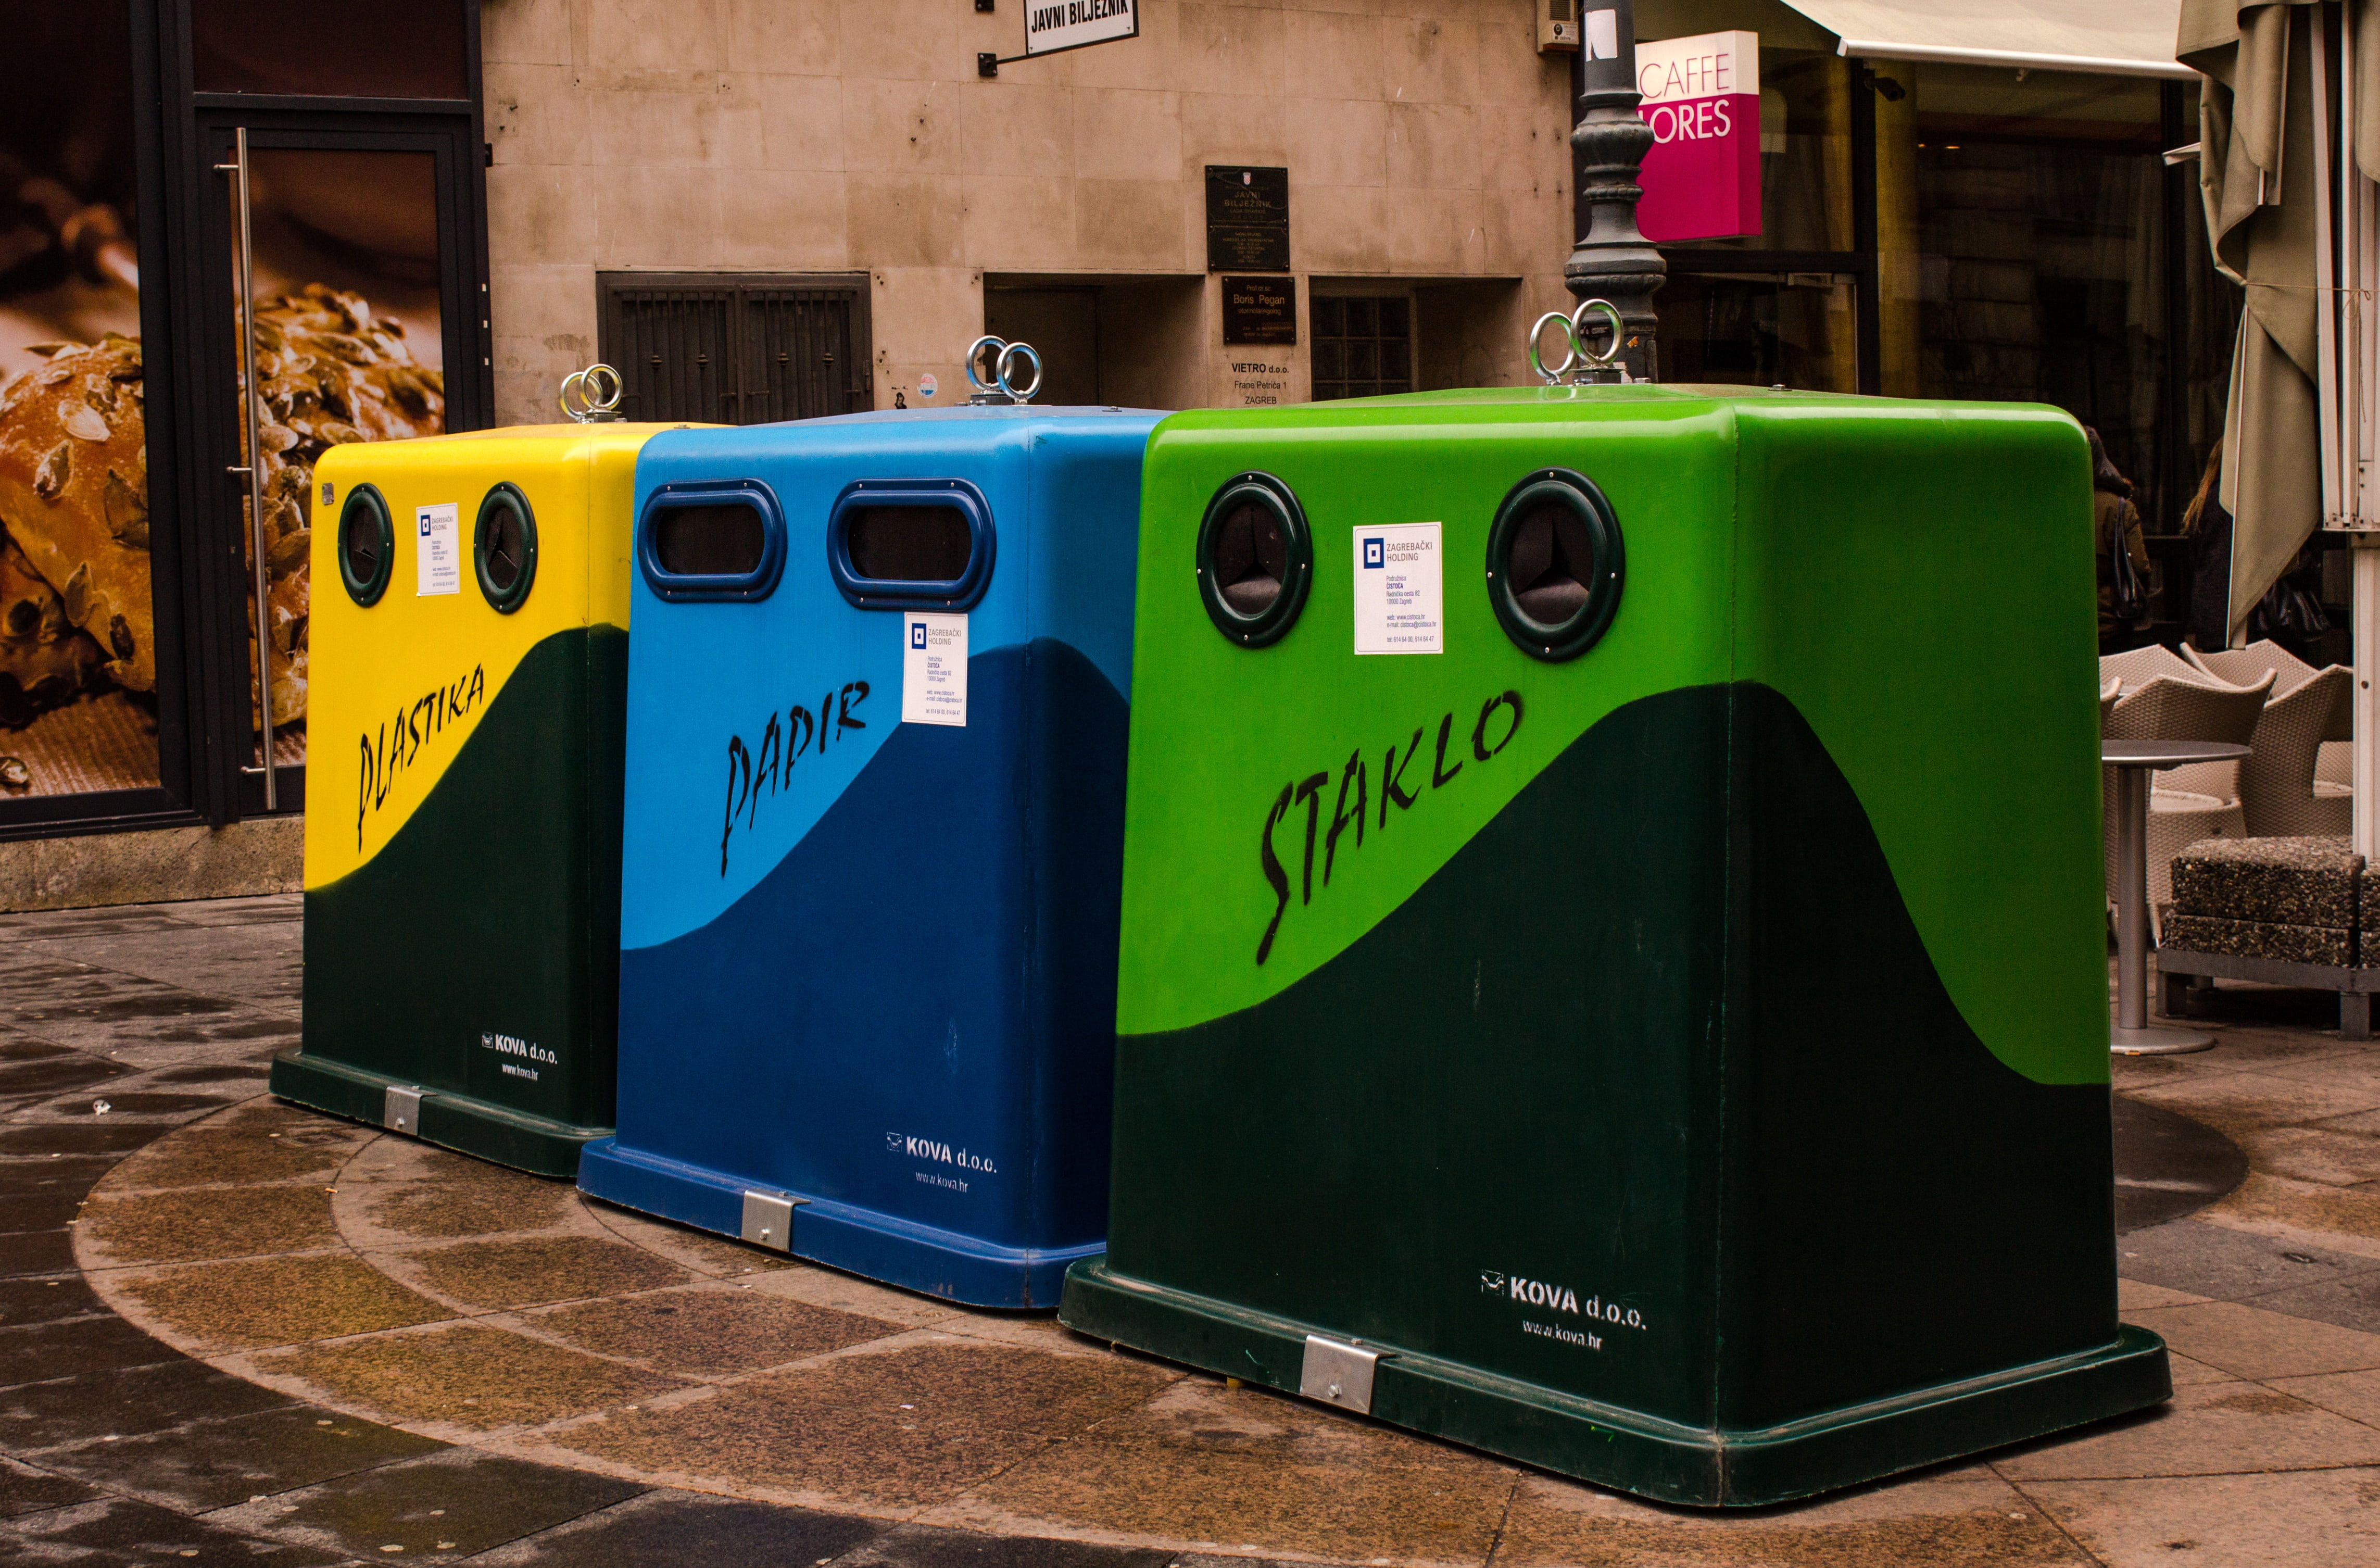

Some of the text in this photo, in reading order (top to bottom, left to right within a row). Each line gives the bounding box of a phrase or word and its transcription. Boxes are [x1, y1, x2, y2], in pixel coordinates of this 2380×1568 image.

[1031, 5, 1065, 33] JAVNI
[1640, 54, 1730, 98] CAFFE
[1639, 99, 1731, 144] ORES
[1233, 294, 1285, 306] Boris Pegan
[1232, 363, 1266, 373] VIETRO
[1235, 381, 1255, 389] Frane
[1256, 381, 1280, 389] Petrića
[1387, 540, 1432, 551] ZAGREBAČKI
[1387, 553, 1419, 561] HOLDING
[928, 628, 962, 637] ZAGREBAČKI
[358, 662, 485, 854] PLASTIKA
[721, 681, 870, 878] PAPIR
[1256, 689, 1525, 966] STAKLO
[495, 1034, 558, 1064] KOVA d.o.o.
[502, 1063, 538, 1082] www.kova.hr
[906, 1136, 997, 1174] KOVA d.o.o.
[915, 1172, 968, 1193] www.kova.hr
[1510, 1276, 1647, 1331] KOVA d.o.o.
[1522, 1320, 1603, 1351] www.kova.hr
